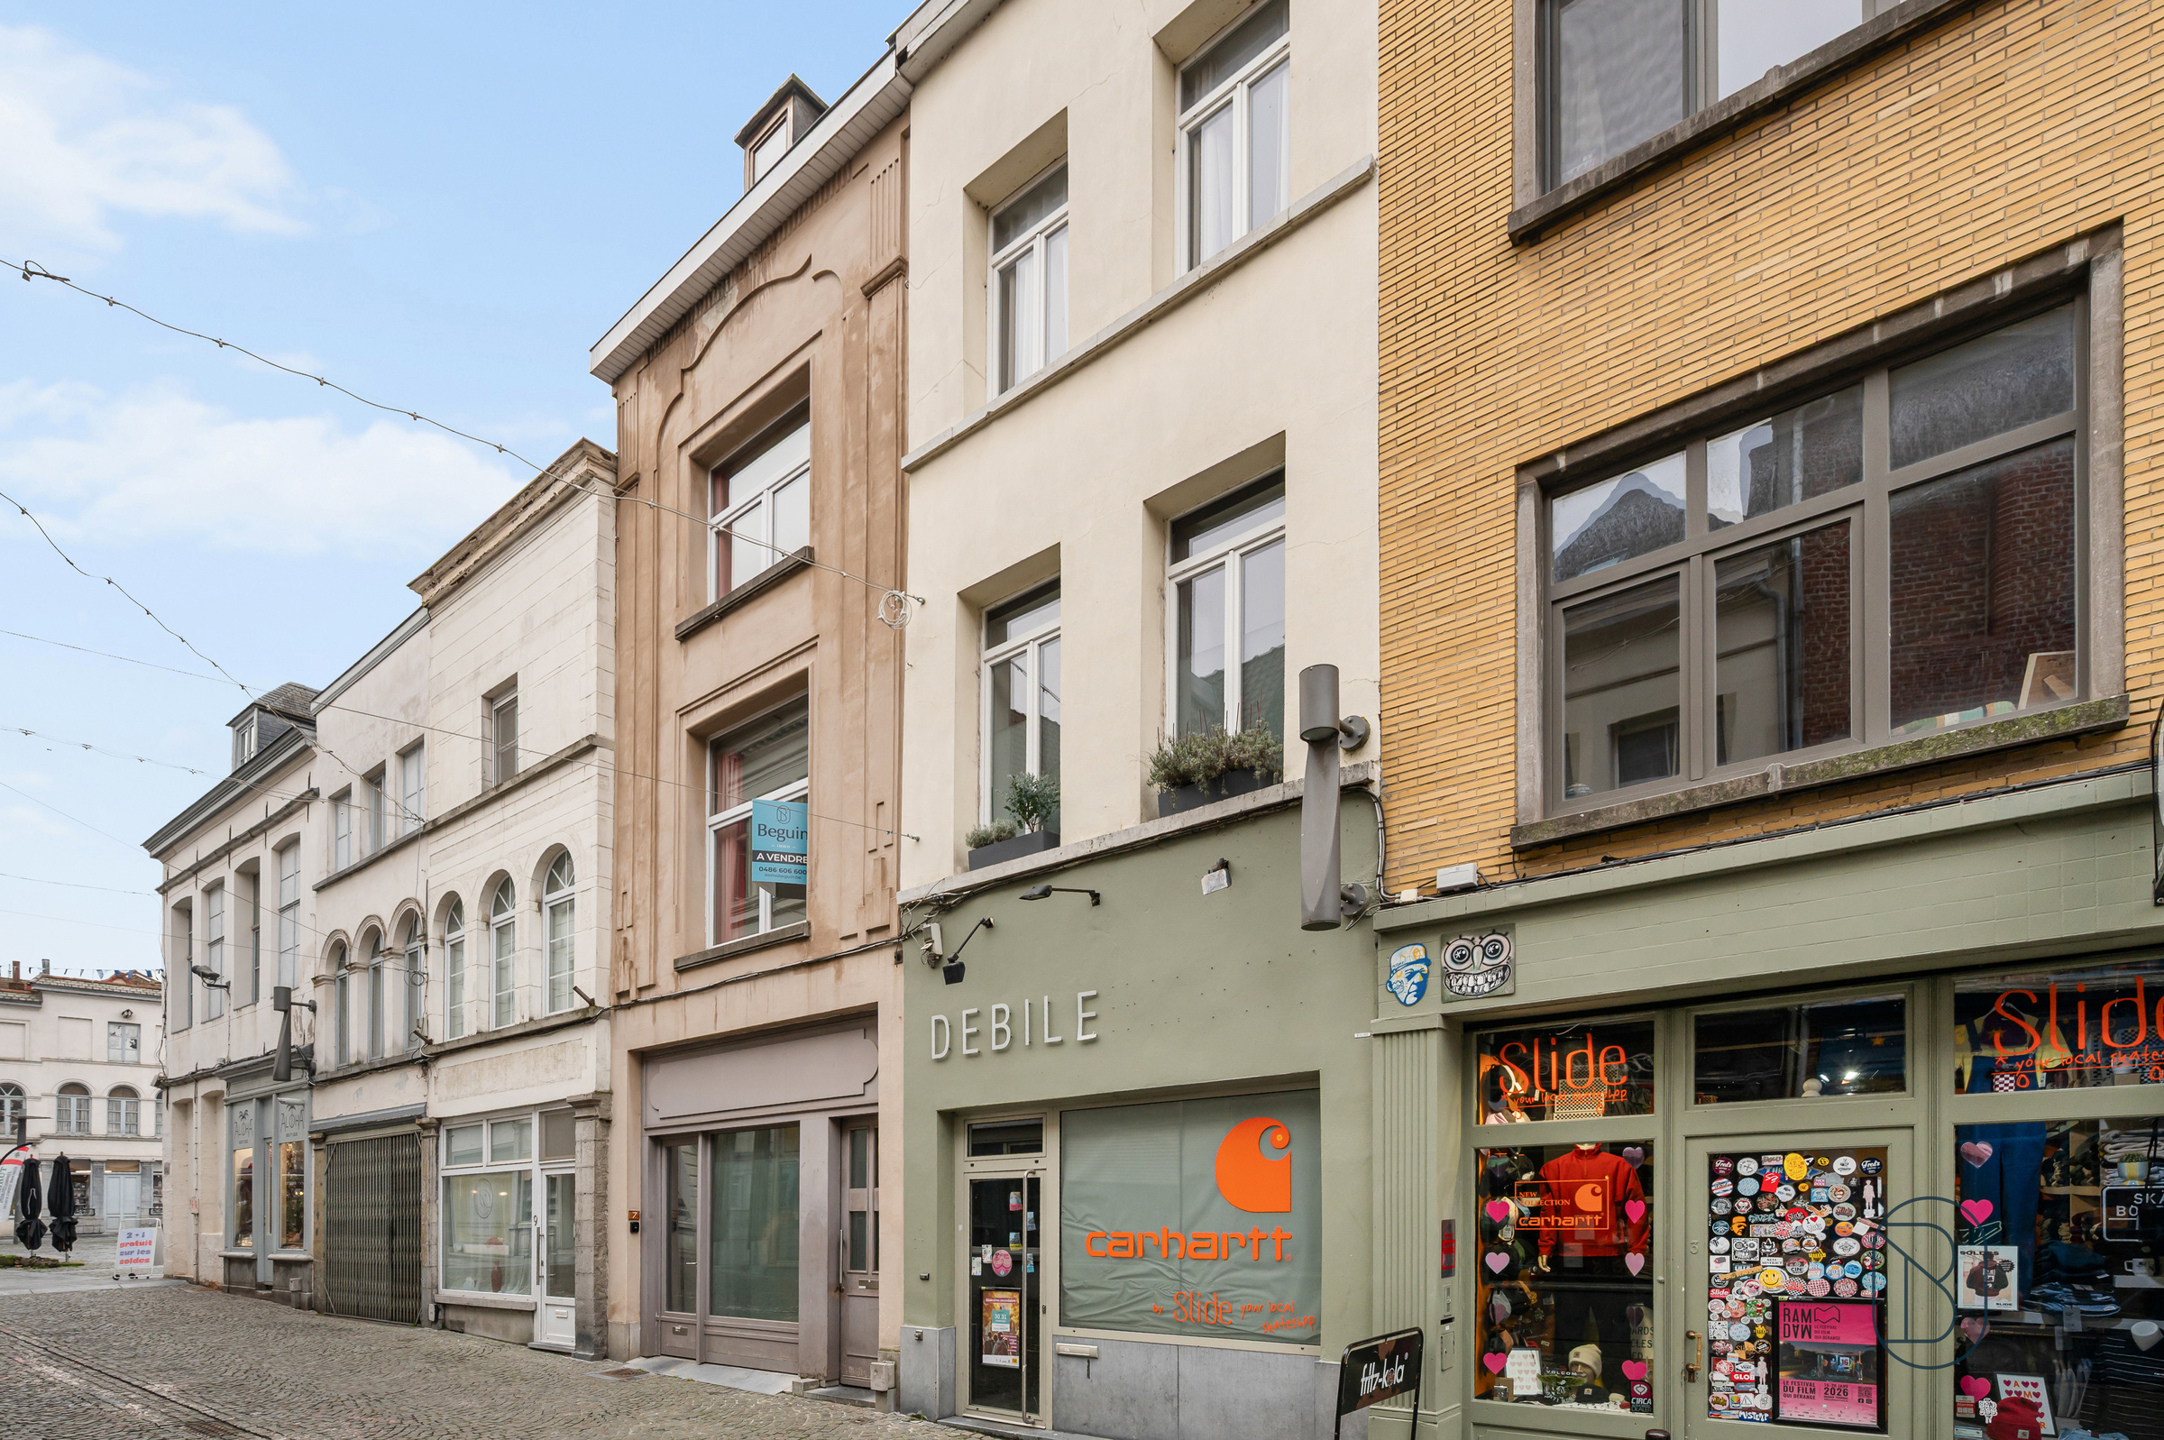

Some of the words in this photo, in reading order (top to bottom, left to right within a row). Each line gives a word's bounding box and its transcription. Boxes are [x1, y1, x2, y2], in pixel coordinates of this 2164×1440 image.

[757, 823, 807, 842] Beguin
[756, 852, 765, 861] A
[766, 853, 807, 864] VENDRE
[1993, 976, 2164, 1055] Slid
[931, 990, 1097, 1060] DEBILE
[1499, 1033, 1628, 1094] Slide
[2015, 1058, 2052, 1077] your
[2060, 1050, 2101, 1067] local
[1514, 1096, 1536, 1105] your
[1541, 1091, 1567, 1102] local
[1572, 1087, 1628, 1102] skateshop
[533, 1215, 538, 1226] 9
[632, 1211, 638, 1219] 7
[1518, 1214, 1602, 1227] carhartt
[119, 1240, 152, 1248] gratuit
[1085, 1226, 1292, 1262] carhartt
[119, 1257, 150, 1265] soldes
[1710, 1288, 1729, 1296] Slide
[1152, 1303, 1164, 1315] by
[1173, 1291, 1233, 1325] Slide
[1240, 1303, 1264, 1319] your
[1267, 1301, 1295, 1314] local
[1783, 1307, 1812, 1324] RAM
[1262, 1314, 1316, 1334] skateshop
[1783, 1385, 1795, 1393] DU
[1824, 1387, 1849, 1397] 2026
[1631, 1397, 1652, 1405] CIRCA
